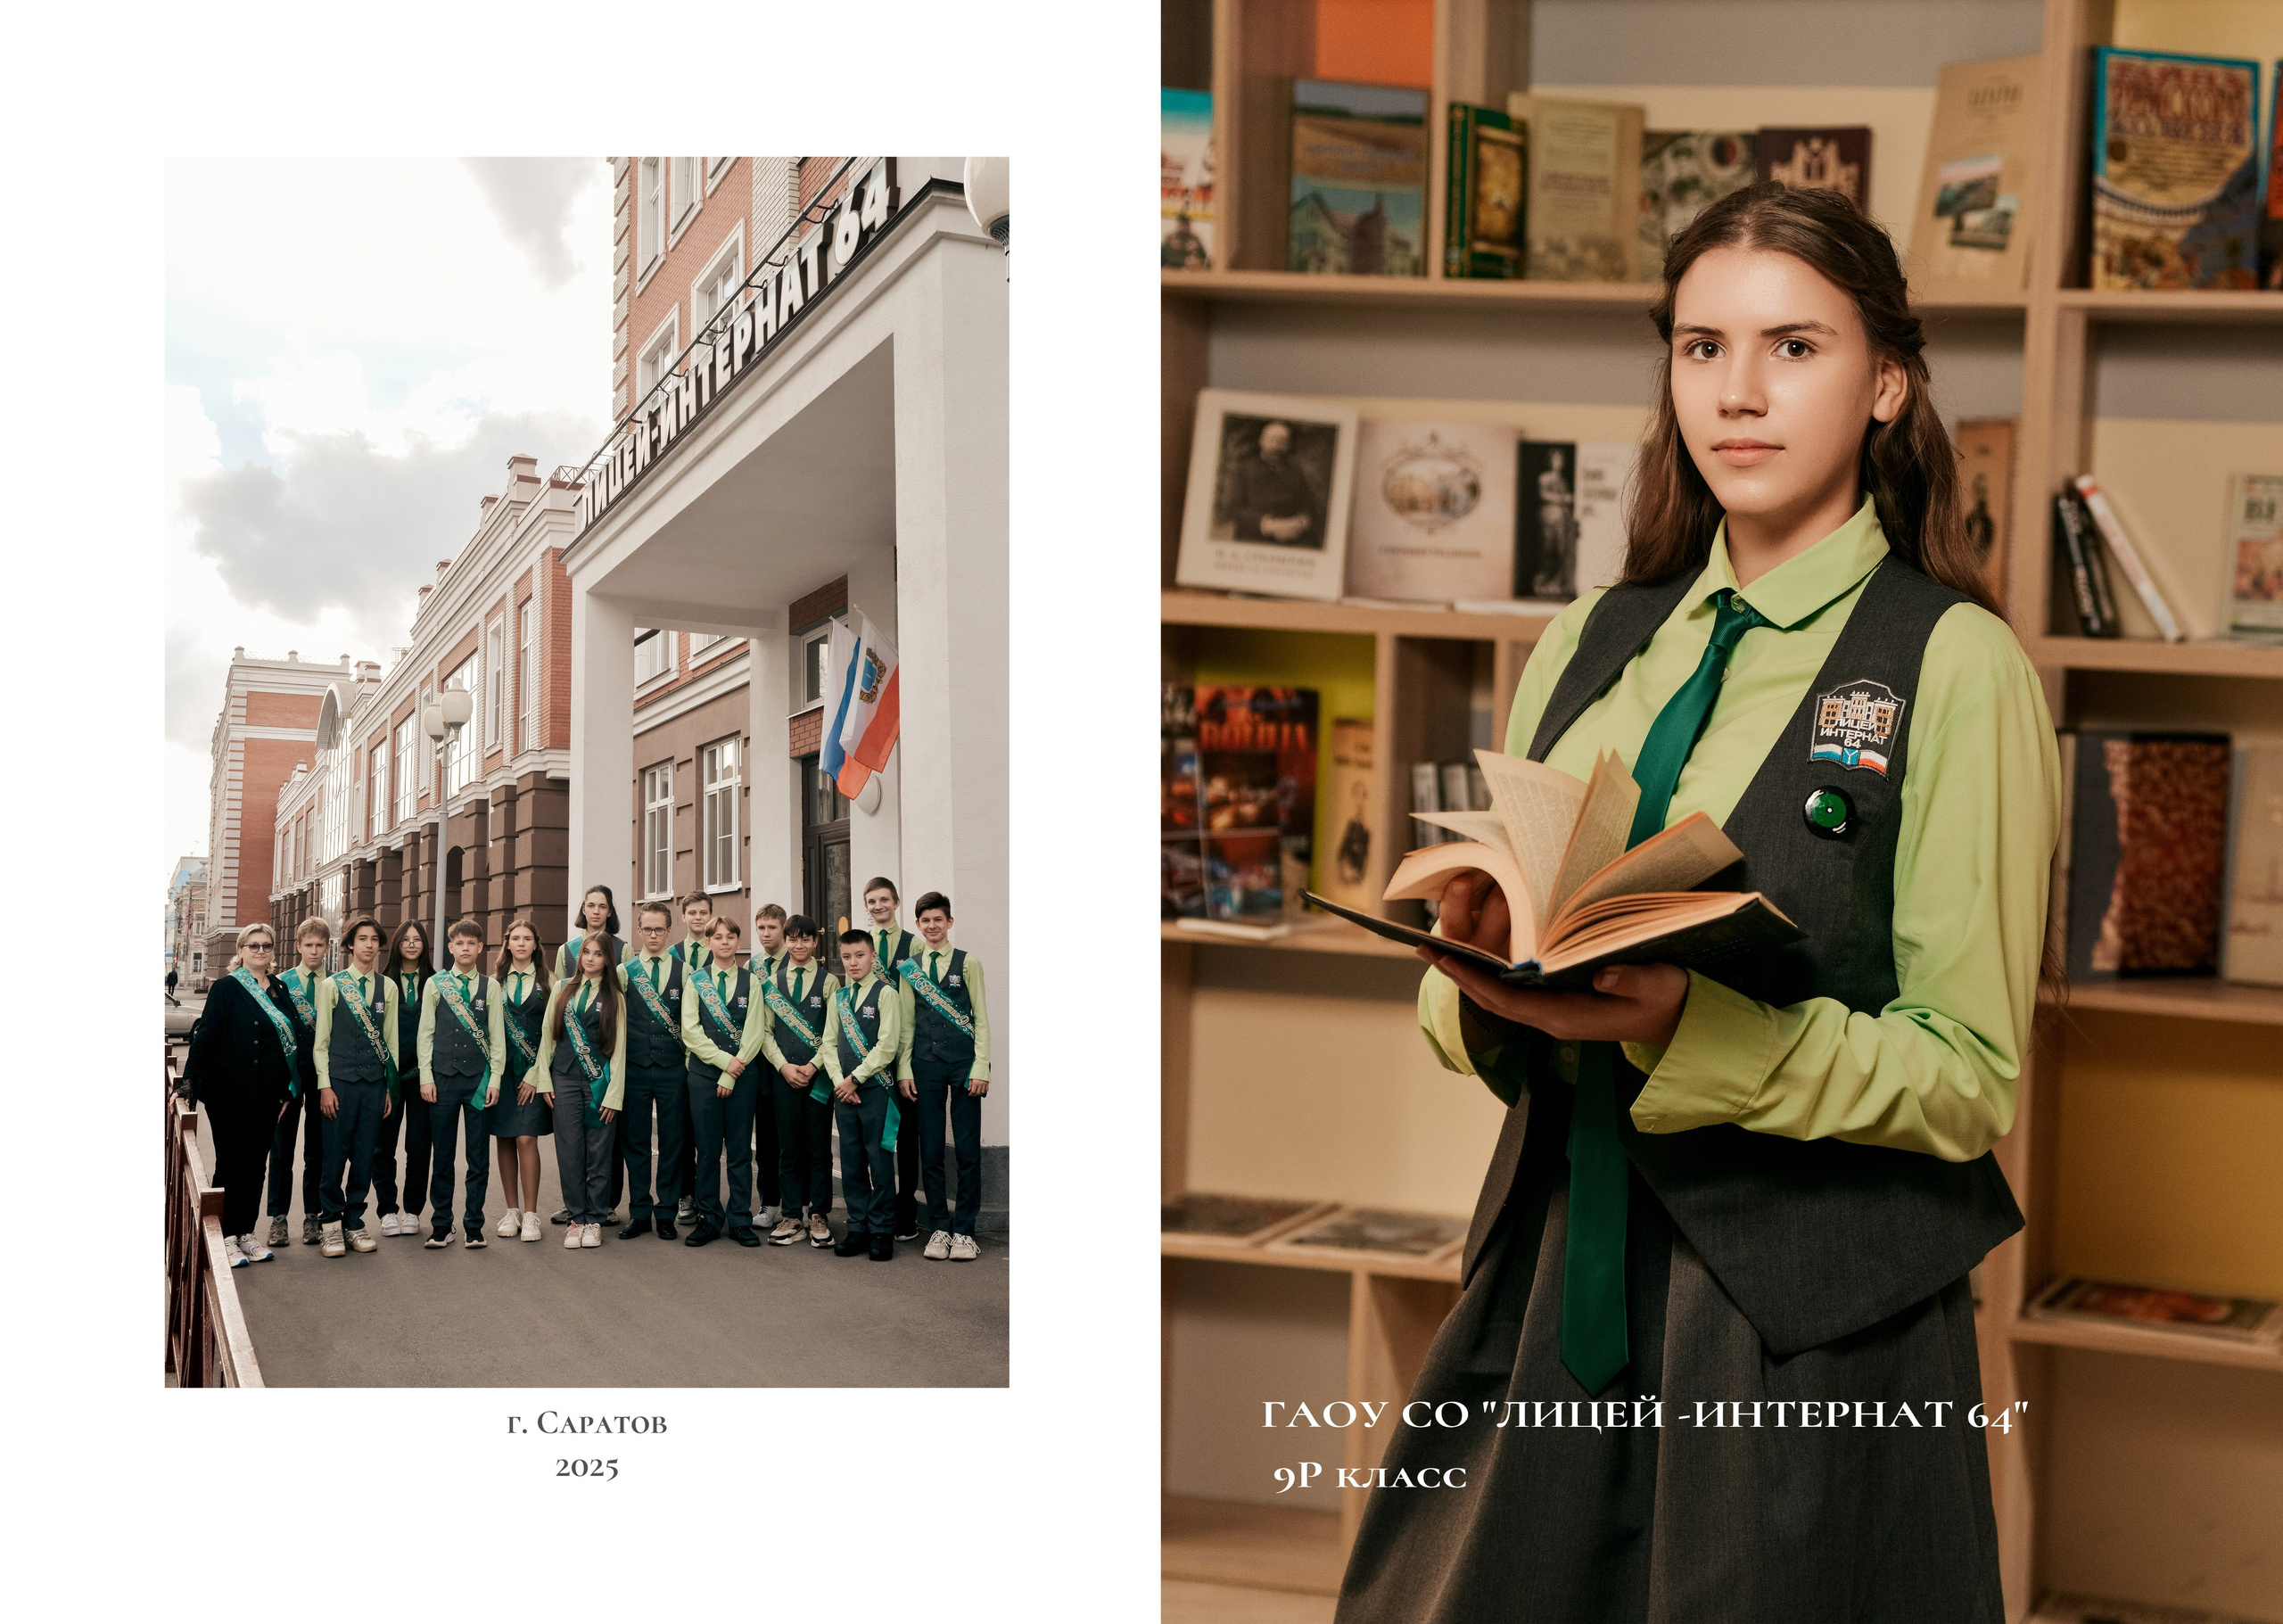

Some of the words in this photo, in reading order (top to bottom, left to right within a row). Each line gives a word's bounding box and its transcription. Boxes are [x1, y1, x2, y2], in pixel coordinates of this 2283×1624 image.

[581, 219, 832, 531] ЛИЦЕЙ-ИНТЕРНАТ
[835, 157, 899, 266] 64
[1820, 728, 1888, 746] ИНТЕРНАТ
[1843, 738, 1862, 749] 64
[955, 1014, 970, 1026] 9
[367, 1029, 381, 1040] 9
[473, 1029, 484, 1039] 9
[511, 1030, 525, 1040] 9
[668, 1024, 681, 1035] 9
[729, 1029, 744, 1041] 9
[809, 1035, 823, 1047] 9
[576, 1045, 591, 1055] 9
